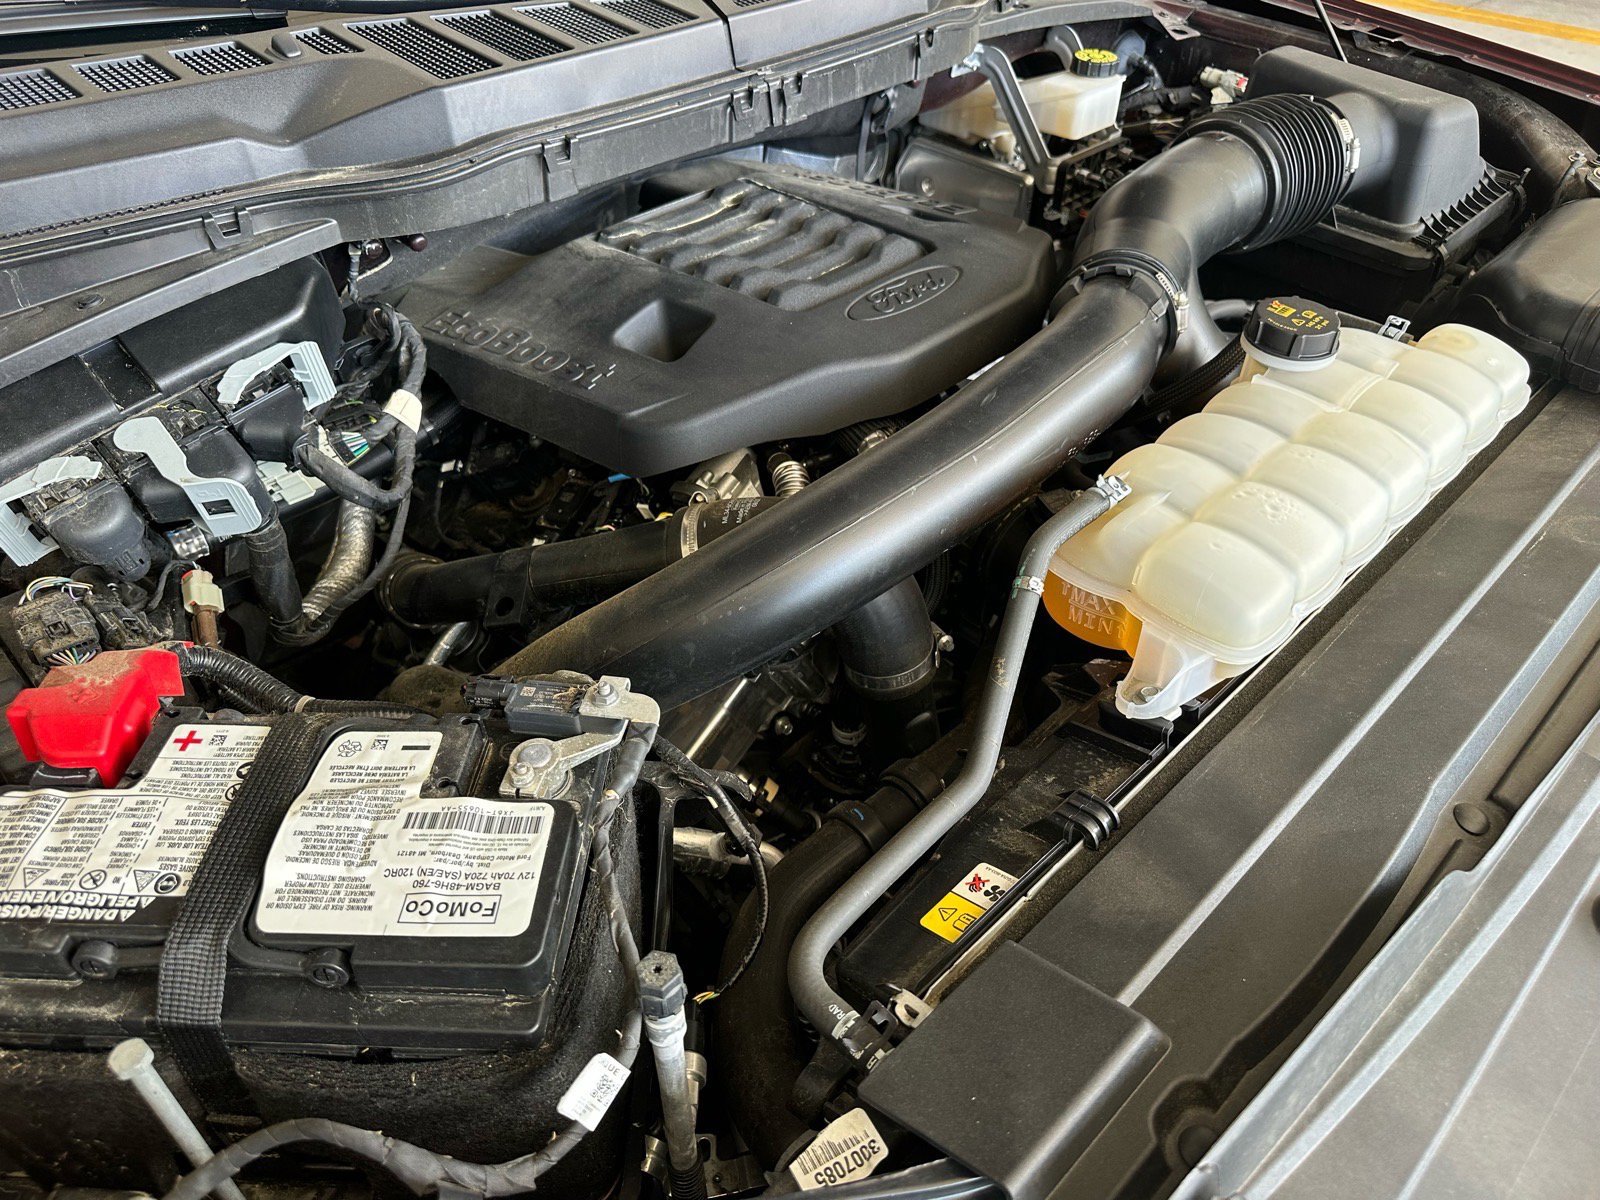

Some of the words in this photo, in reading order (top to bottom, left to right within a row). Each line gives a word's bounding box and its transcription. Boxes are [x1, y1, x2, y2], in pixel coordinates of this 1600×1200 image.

[866, 279, 945, 313] Ford
[423, 310, 616, 389] EcoBoost
[1070, 587, 1114, 614] MAX
[1068, 605, 1113, 634] MIN
[342, 825, 373, 833] CORRECTAS
[328, 838, 367, 846] RECOMENDADO
[158, 862, 178, 871] GASES
[320, 857, 340, 866] RIESGO
[383, 867, 413, 877] 120RC
[416, 866, 462, 878] (SAE/EN)
[463, 871, 487, 879] 720A
[489, 871, 515, 879] 70Ah
[412, 879, 501, 890] BAGM-48H6-760
[405, 899, 496, 916] FoMoCo
[827, 1002, 845, 1019] RAD
[814, 1139, 880, 1184] 3007085
